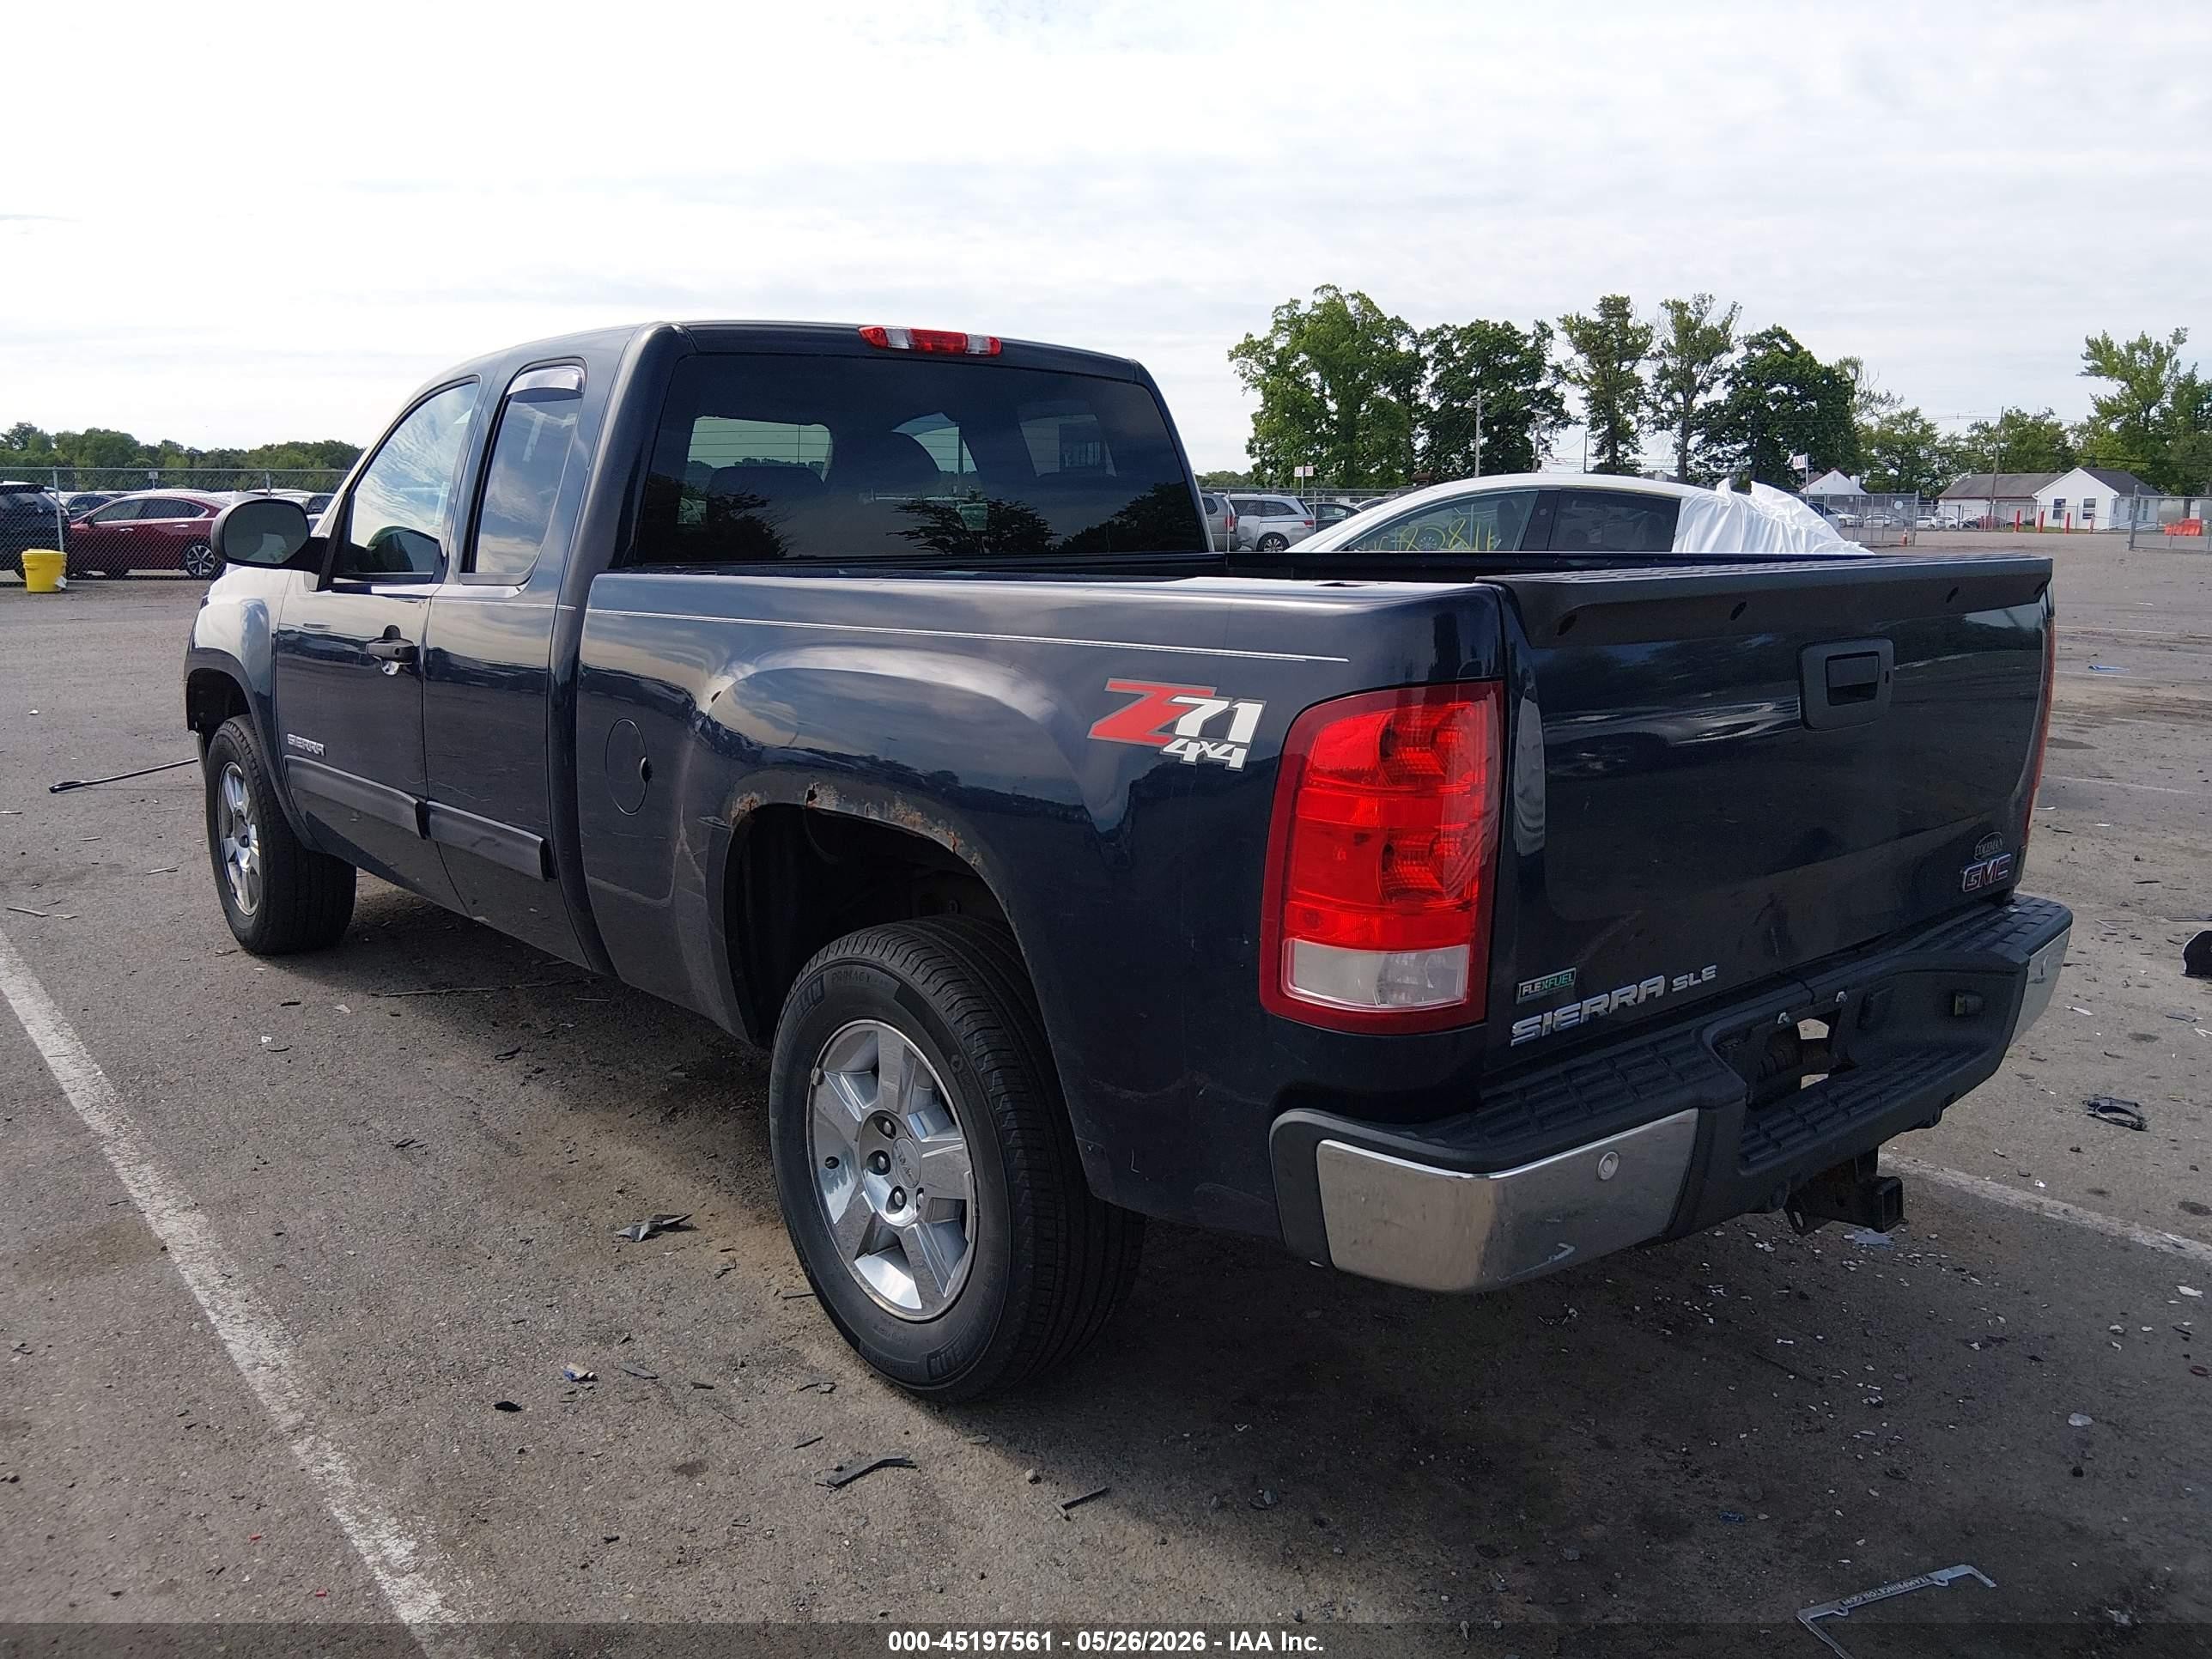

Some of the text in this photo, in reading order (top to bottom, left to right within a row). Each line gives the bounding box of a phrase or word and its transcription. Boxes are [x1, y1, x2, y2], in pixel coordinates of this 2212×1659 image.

[1086, 678, 1267, 746] Z71
[288, 733, 325, 756] SIERRA
[1962, 853, 2011, 892] GMC
[1522, 969, 1574, 997] FLEXFUEL
[1510, 964, 1717, 1047] SIERRA SLE
